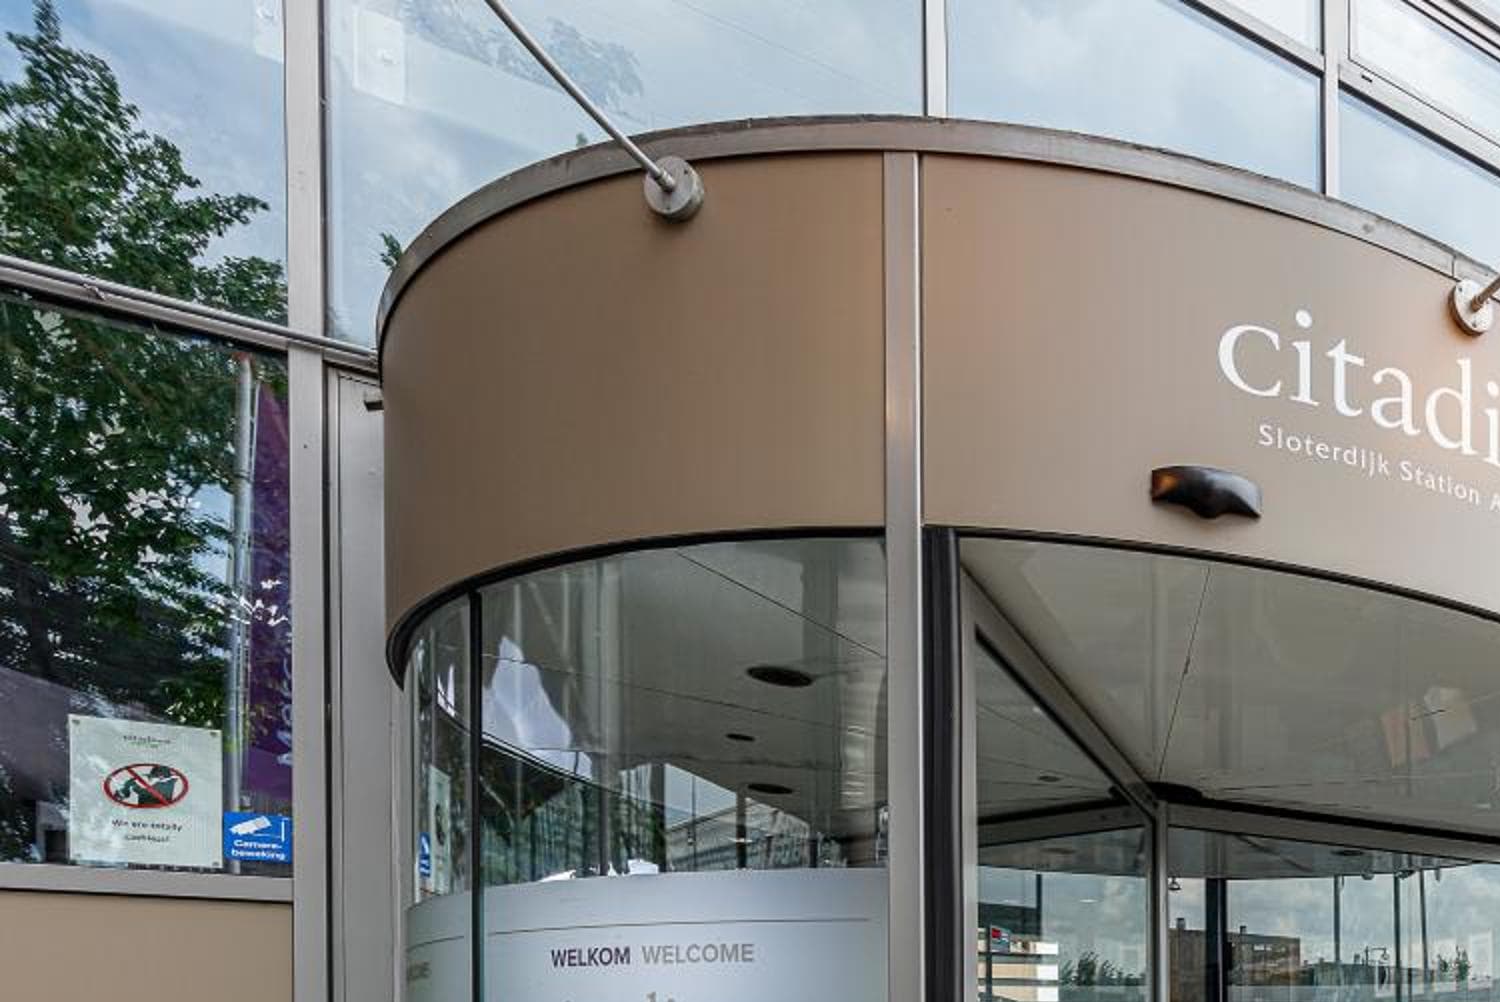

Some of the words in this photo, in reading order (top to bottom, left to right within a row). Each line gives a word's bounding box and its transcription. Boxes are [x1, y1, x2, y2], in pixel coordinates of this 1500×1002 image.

[1257, 424, 1390, 478] Sloterdijk
[1399, 461, 1481, 507] Station
[551, 947, 632, 967] WELKOM
[642, 943, 755, 963] WELCOME
